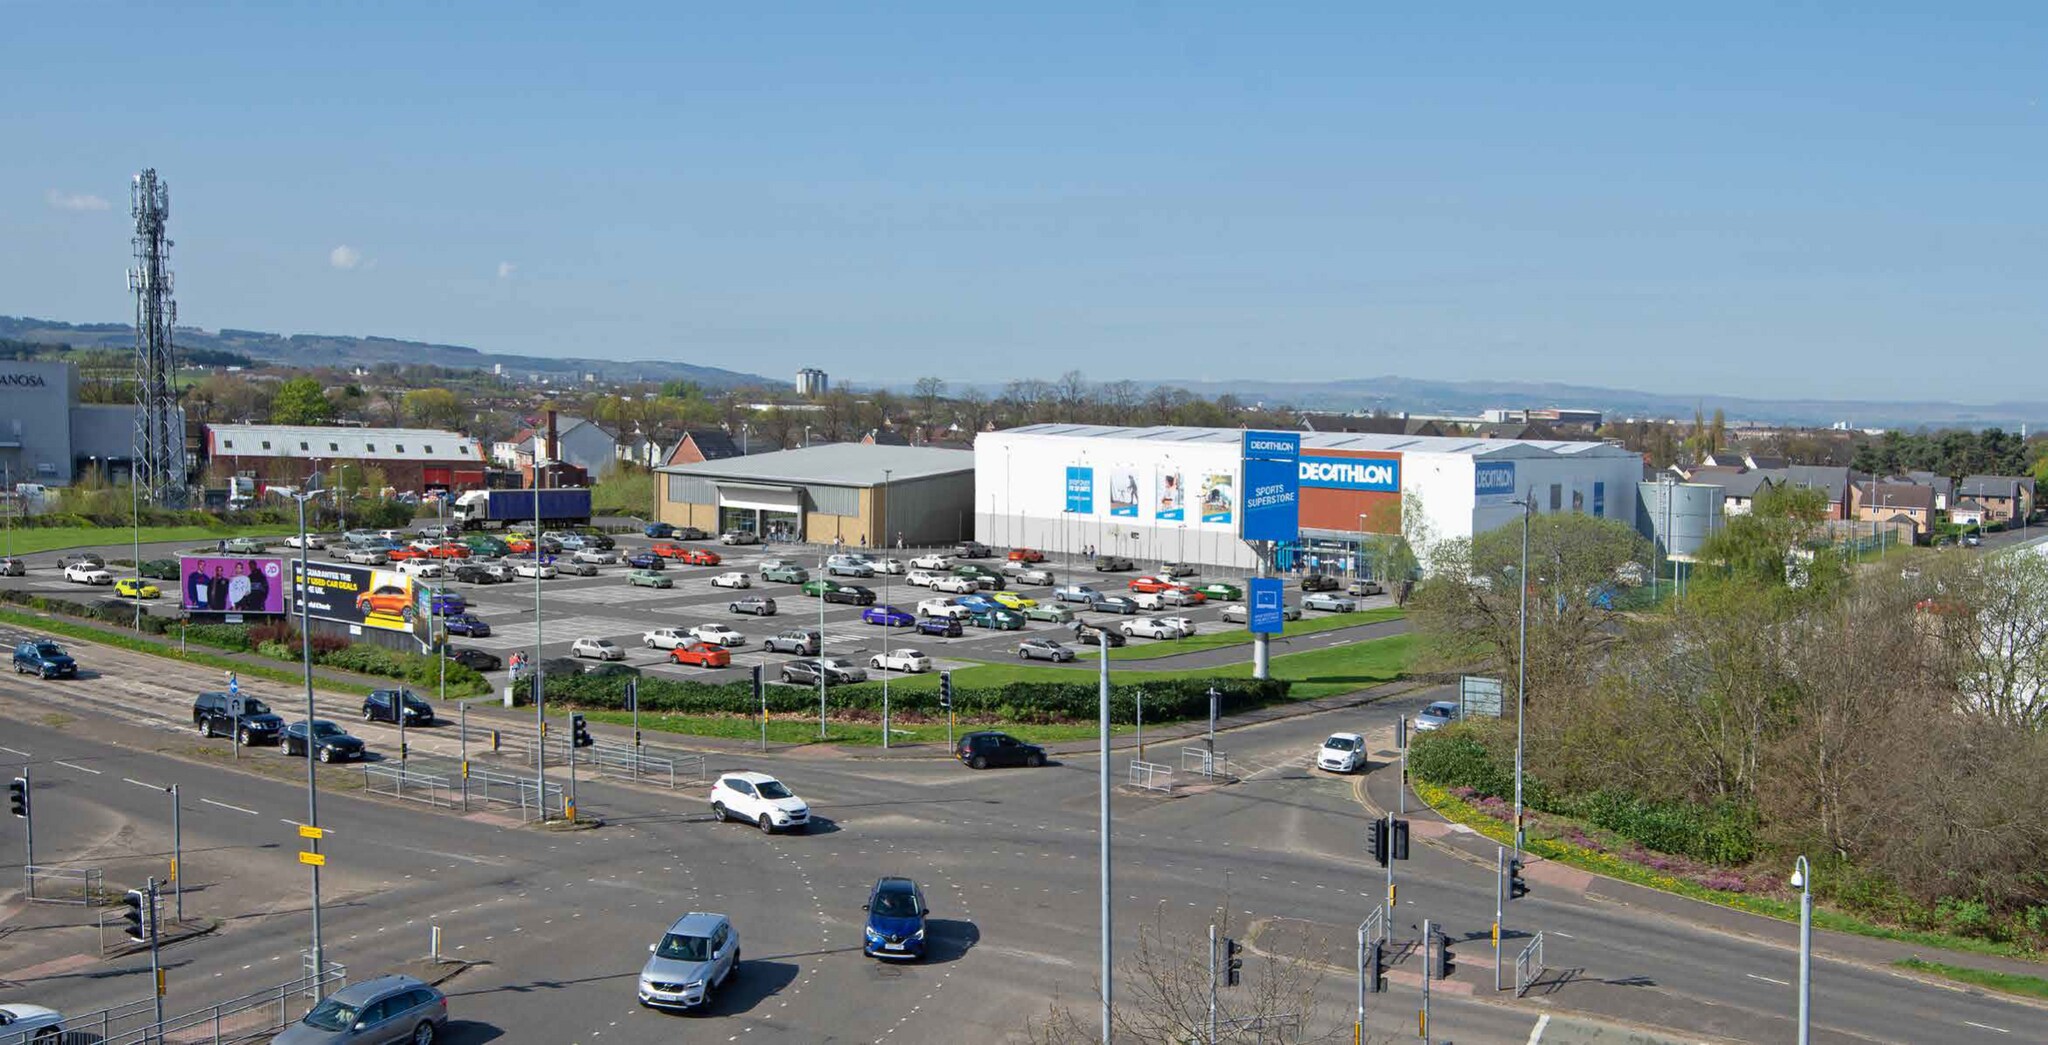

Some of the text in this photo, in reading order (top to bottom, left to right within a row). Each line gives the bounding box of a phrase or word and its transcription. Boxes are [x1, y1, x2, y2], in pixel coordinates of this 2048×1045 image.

[0, 374, 46, 387] ANOSA
[1250, 441, 1294, 451] DECATHLON
[1299, 462, 1392, 484] DECATHLON
[1477, 469, 1513, 488] DECATHLON
[1255, 484, 1285, 497] SPORTS
[1247, 492, 1295, 508] SUPERSTORE
[296, 575, 358, 591] BET USED CAR DEALS
